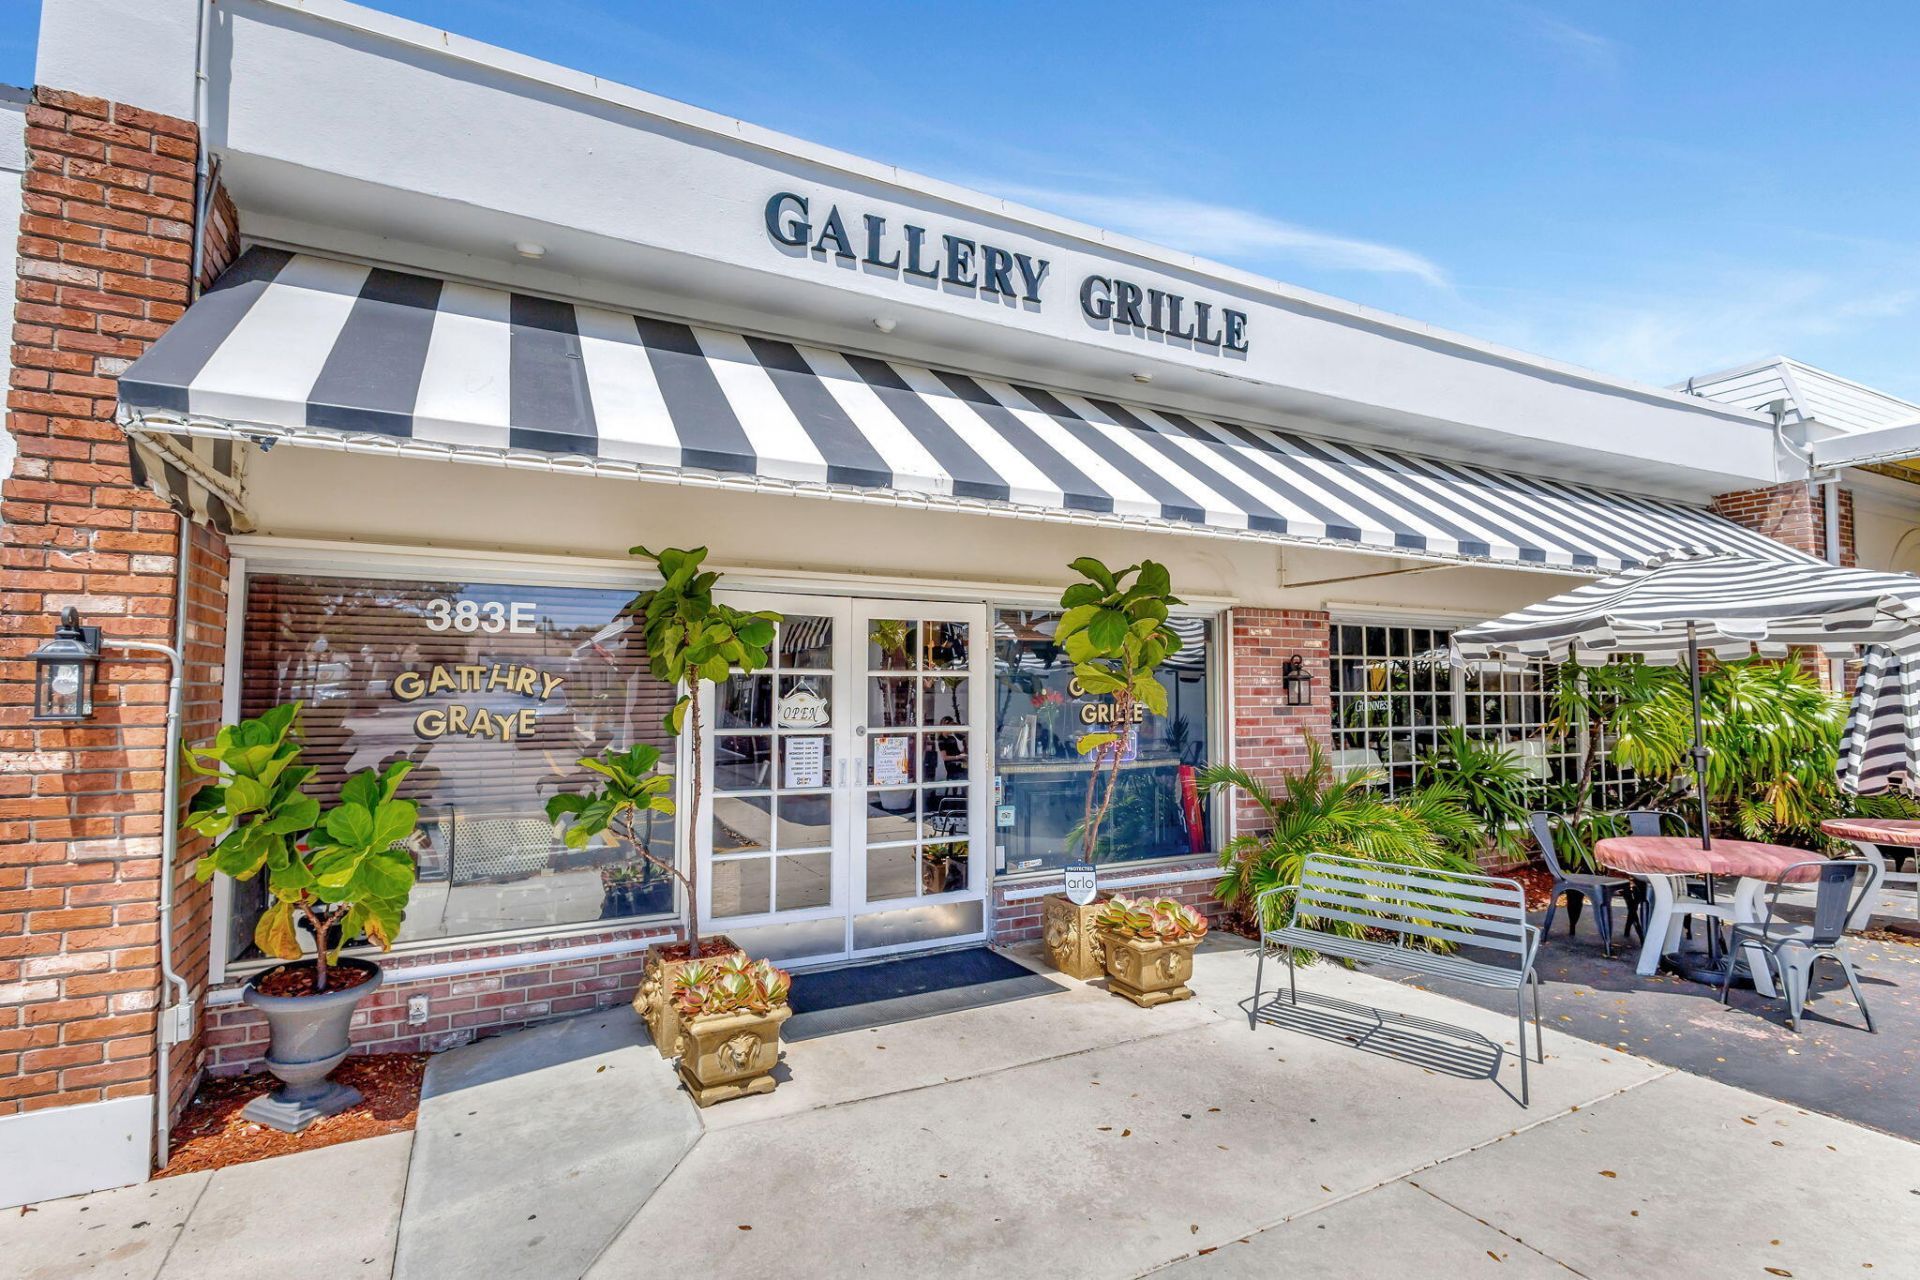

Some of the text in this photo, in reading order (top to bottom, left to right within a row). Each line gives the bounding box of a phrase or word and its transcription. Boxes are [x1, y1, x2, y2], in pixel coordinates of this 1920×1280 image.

[765, 192, 1249, 353] GALLERY GRILLE
[426, 599, 537, 634] 383E
[414, 705, 537, 741] GRAYE
[783, 706, 819, 722] OPEN
[1080, 702, 1143, 725] GRILE
[1096, 740, 1131, 752] PEN
[1068, 876, 1094, 889] arlo
